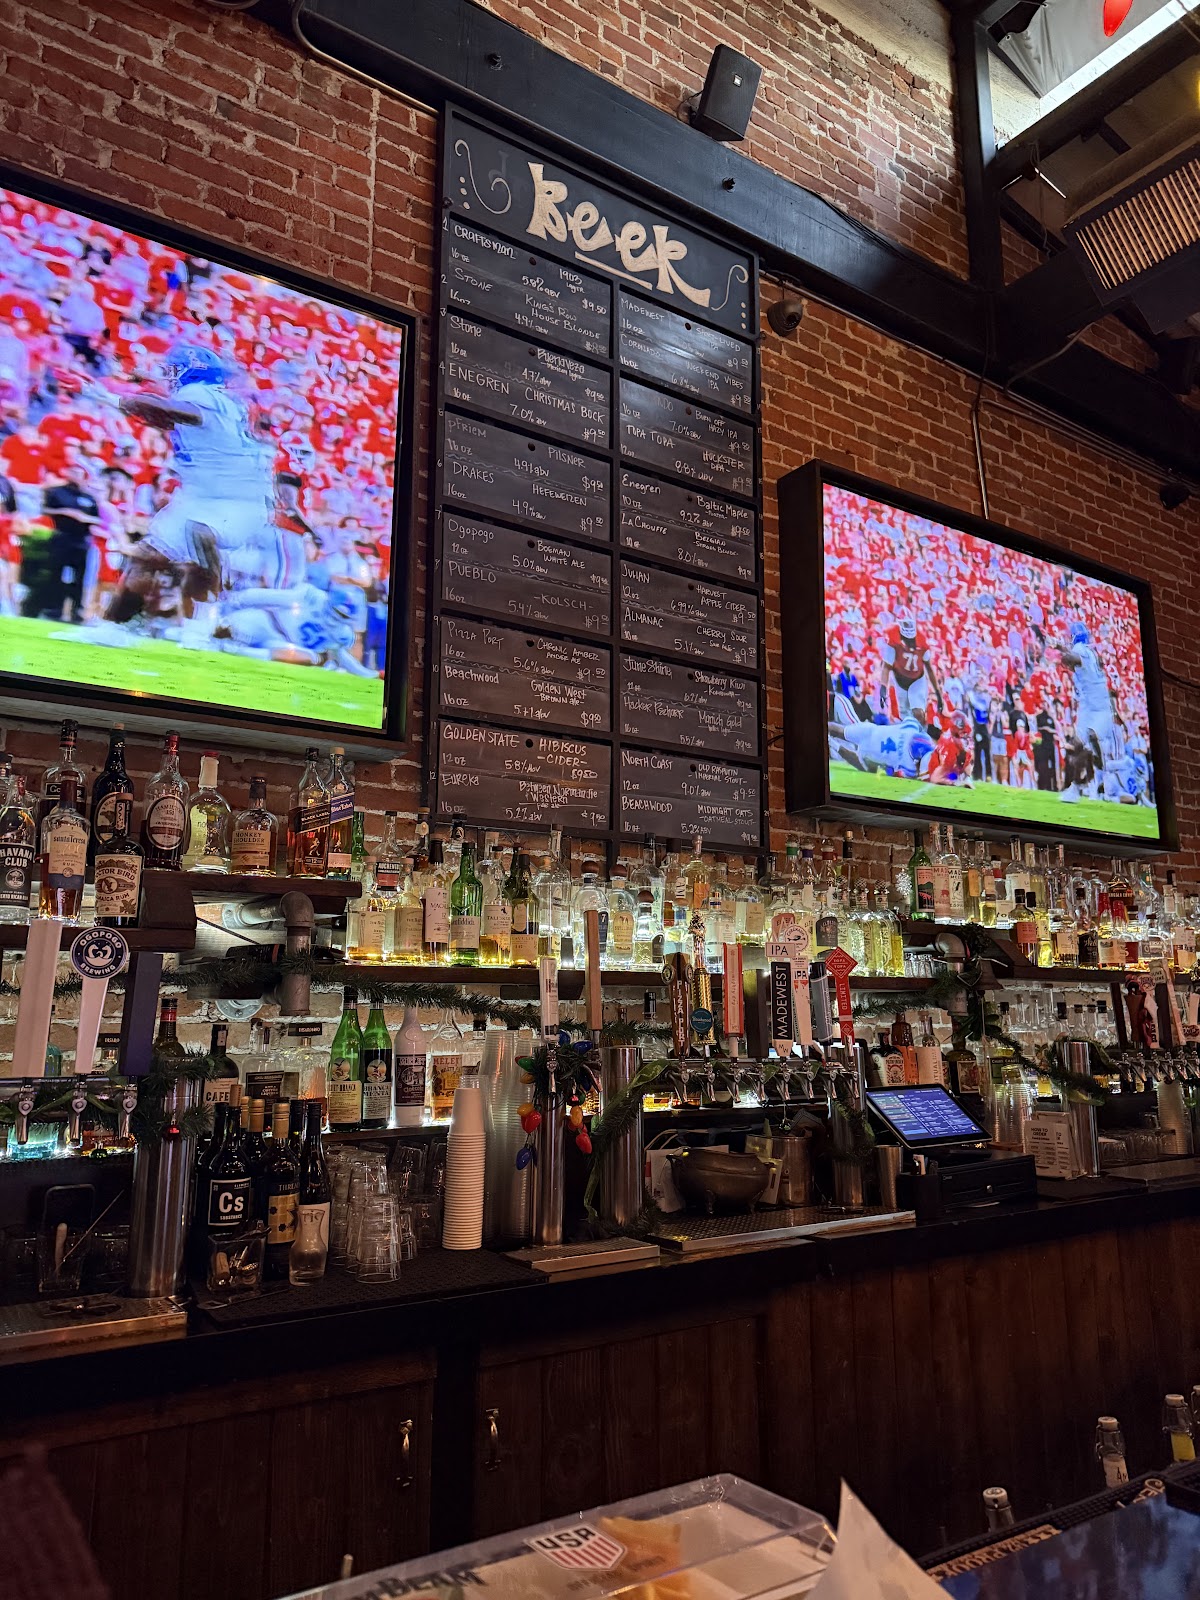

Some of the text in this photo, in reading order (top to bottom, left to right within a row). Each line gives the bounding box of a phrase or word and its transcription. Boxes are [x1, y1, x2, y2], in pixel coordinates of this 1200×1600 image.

[441, 275, 447, 283] 2
[455, 268, 493, 291] STONE
[560, 269, 582, 284] 1903
[621, 298, 664, 322] MADEWEST
[450, 316, 482, 337] Stone
[439, 361, 445, 375] 4
[449, 362, 605, 424] ENEGREN CHRISTMAS BOCK
[724, 376, 743, 389] VIBES
[728, 429, 737, 439] IPA
[650, 431, 675, 448] TOPA
[703, 450, 745, 470] HUCKSTER
[437, 459, 442, 467] 6
[453, 462, 494, 483] DRAKES
[622, 474, 748, 519] Enegren Baltic Maple
[448, 519, 494, 544] Ogopogo
[449, 561, 496, 583] PUEBLO
[543, 554, 585, 569] WHITE ALE
[696, 584, 727, 599] HARVEST
[725, 602, 746, 612] CIDER
[624, 607, 664, 628] ALMANAC
[696, 626, 726, 644] CHERRY
[483, 629, 504, 649] PORT
[537, 638, 567, 655] CHRONIC
[903, 652, 919, 672] 71
[445, 665, 586, 699] Beachwood West
[443, 724, 586, 756] GOLDEN STATE HIBISCUS
[622, 751, 648, 768] NORTH
[651, 756, 673, 770] COAST
[698, 764, 710, 772] OLD
[623, 780, 631, 790] 12
[622, 796, 753, 817] BEACHWOOD MIDNIGHT OATS
[4, 857, 28, 868] CLUB
[116, 868, 135, 880] BIRD
[79, 931, 123, 950] OGOPOGO
[771, 945, 789, 955] IPA
[80, 963, 117, 976] BREWING
[795, 971, 808, 980] IPA
[776, 966, 787, 1039] MADEWEST
[839, 983, 848, 1011] LIMITED
[678, 1017, 686, 1047] PORT
[206, 1091, 230, 1102] CAFE
[218, 1192, 244, 1213] Cs
[535, 1527, 597, 1550] USA
